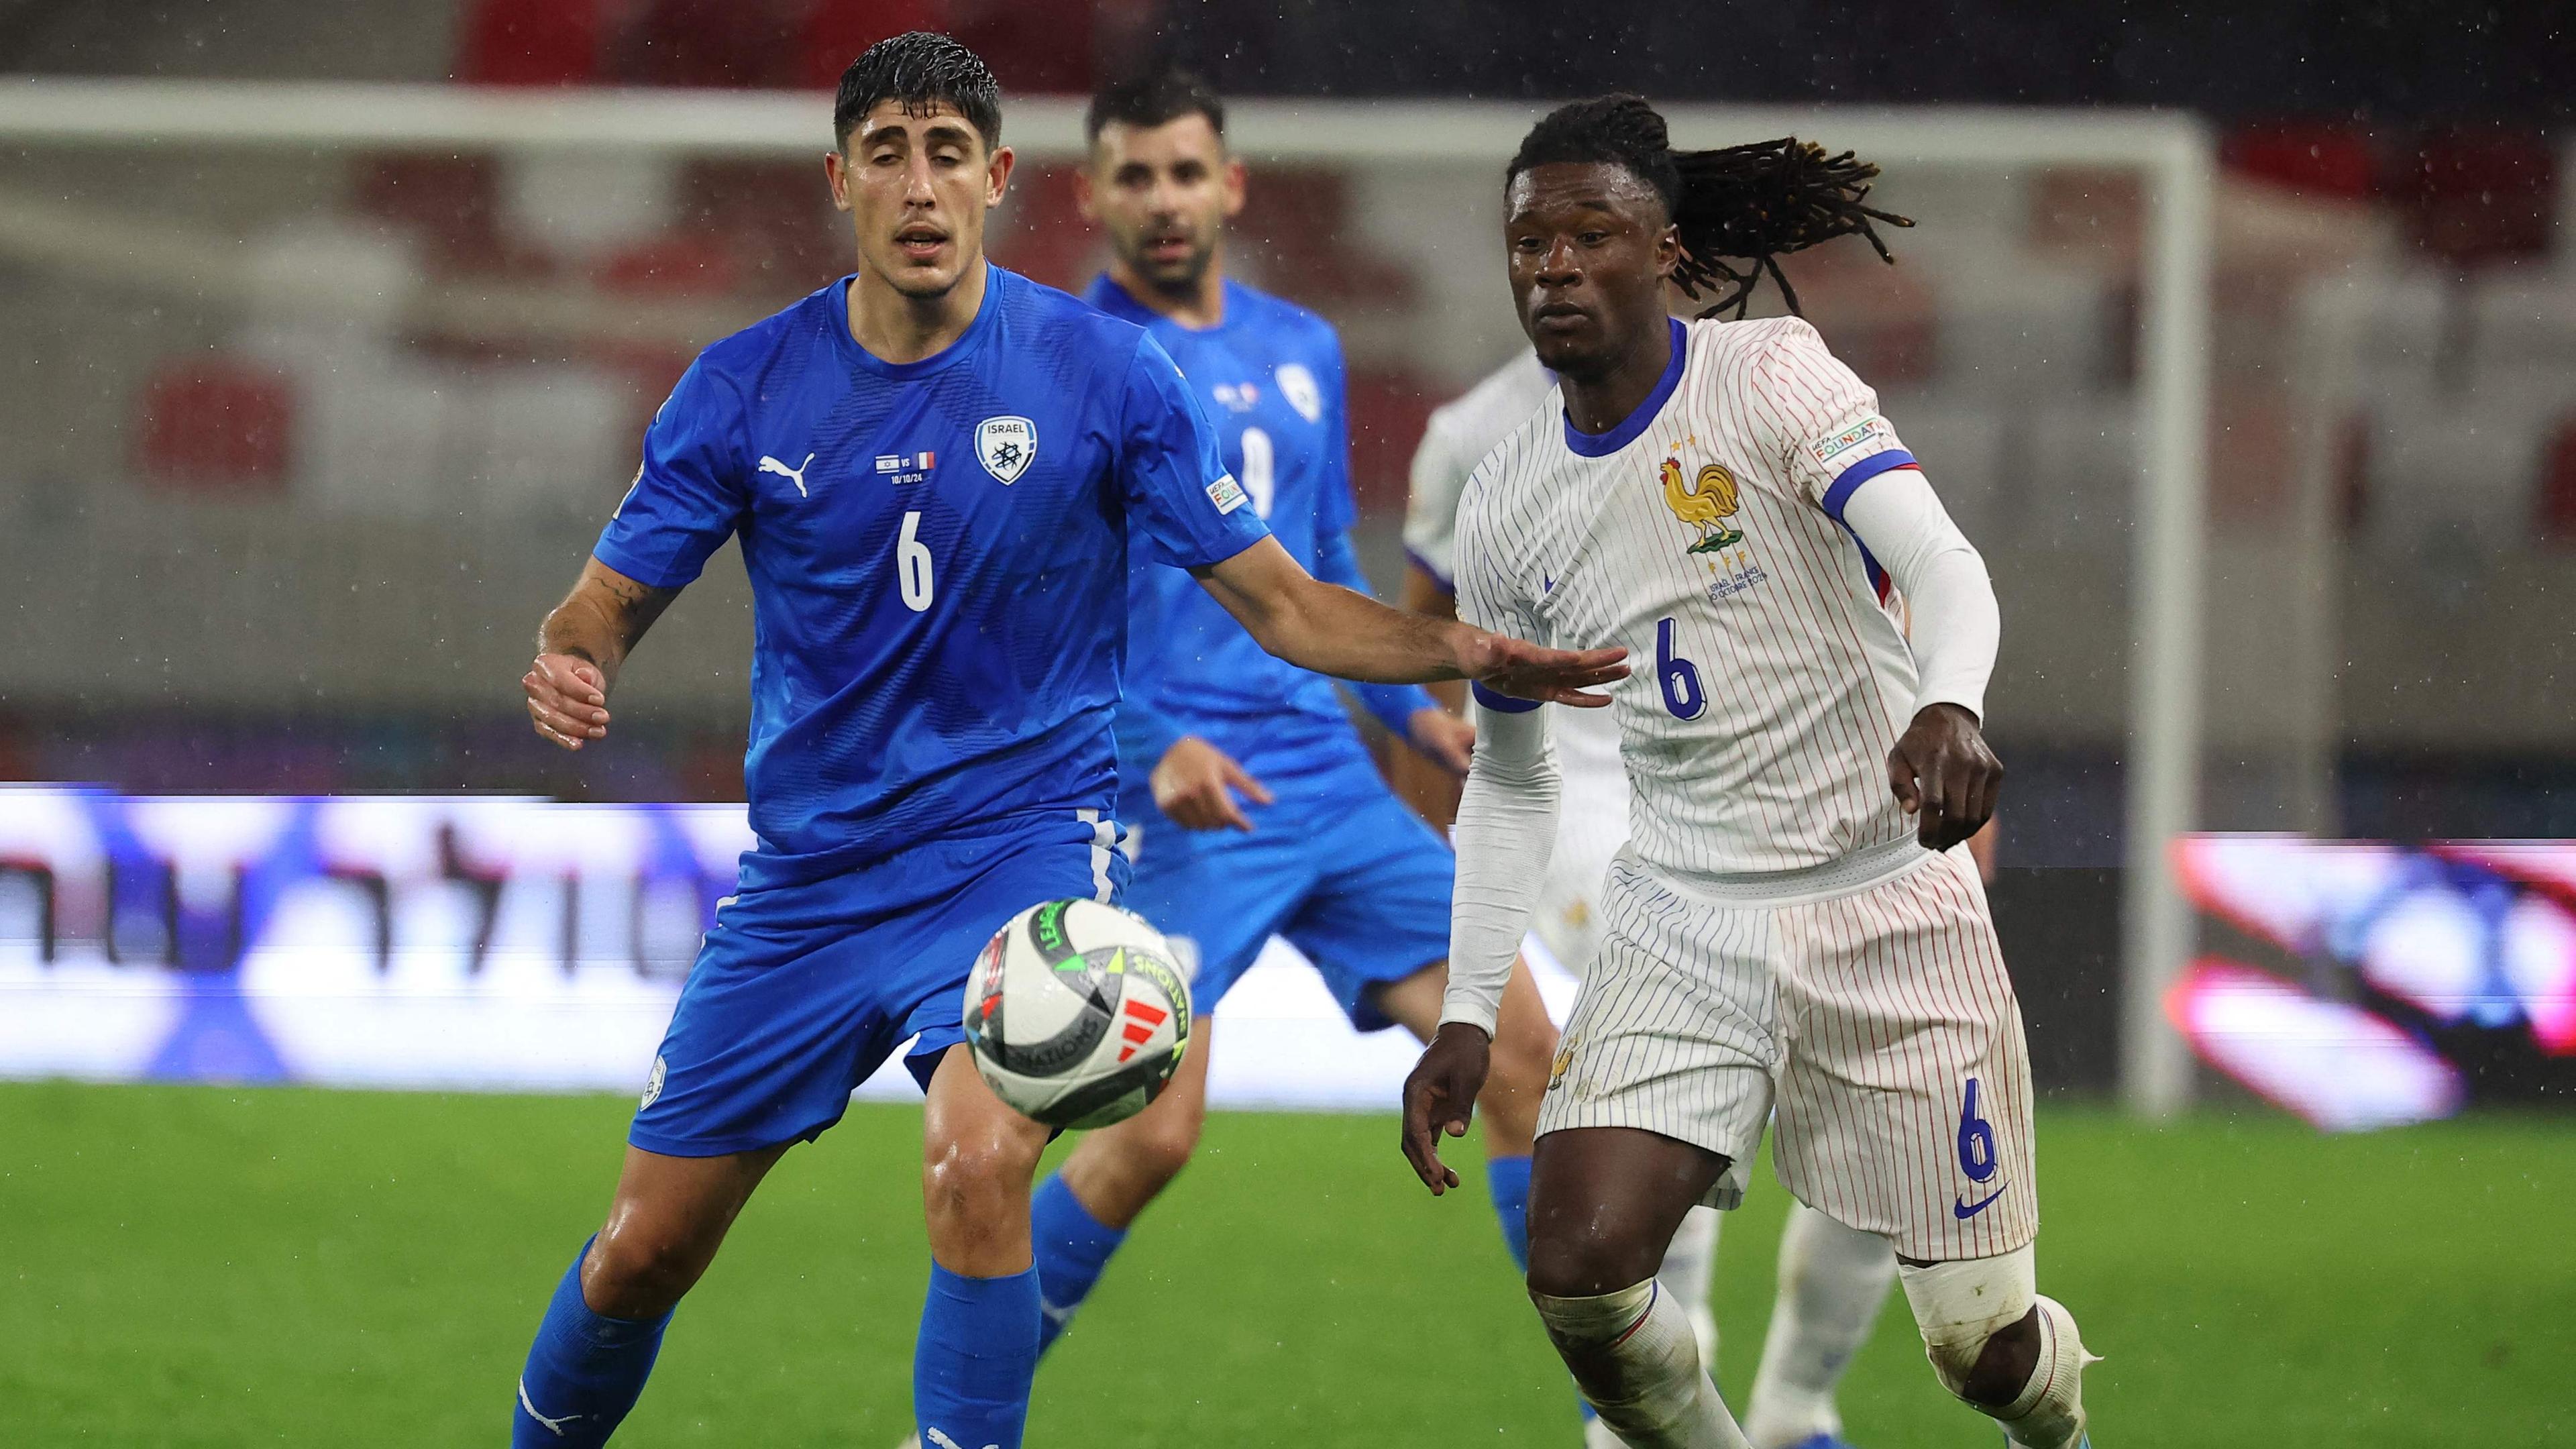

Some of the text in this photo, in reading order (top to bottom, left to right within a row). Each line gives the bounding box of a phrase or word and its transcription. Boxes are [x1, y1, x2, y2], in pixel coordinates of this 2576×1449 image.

[987, 424, 1024, 434] ISRAEL
[1812, 436, 1831, 450] UEFA
[901, 458, 910, 468] VS
[891, 474, 922, 484] 10/10/24
[898, 511, 933, 612] 6
[1656, 616, 1708, 722] 6
[1957, 1077, 1998, 1183] 6
